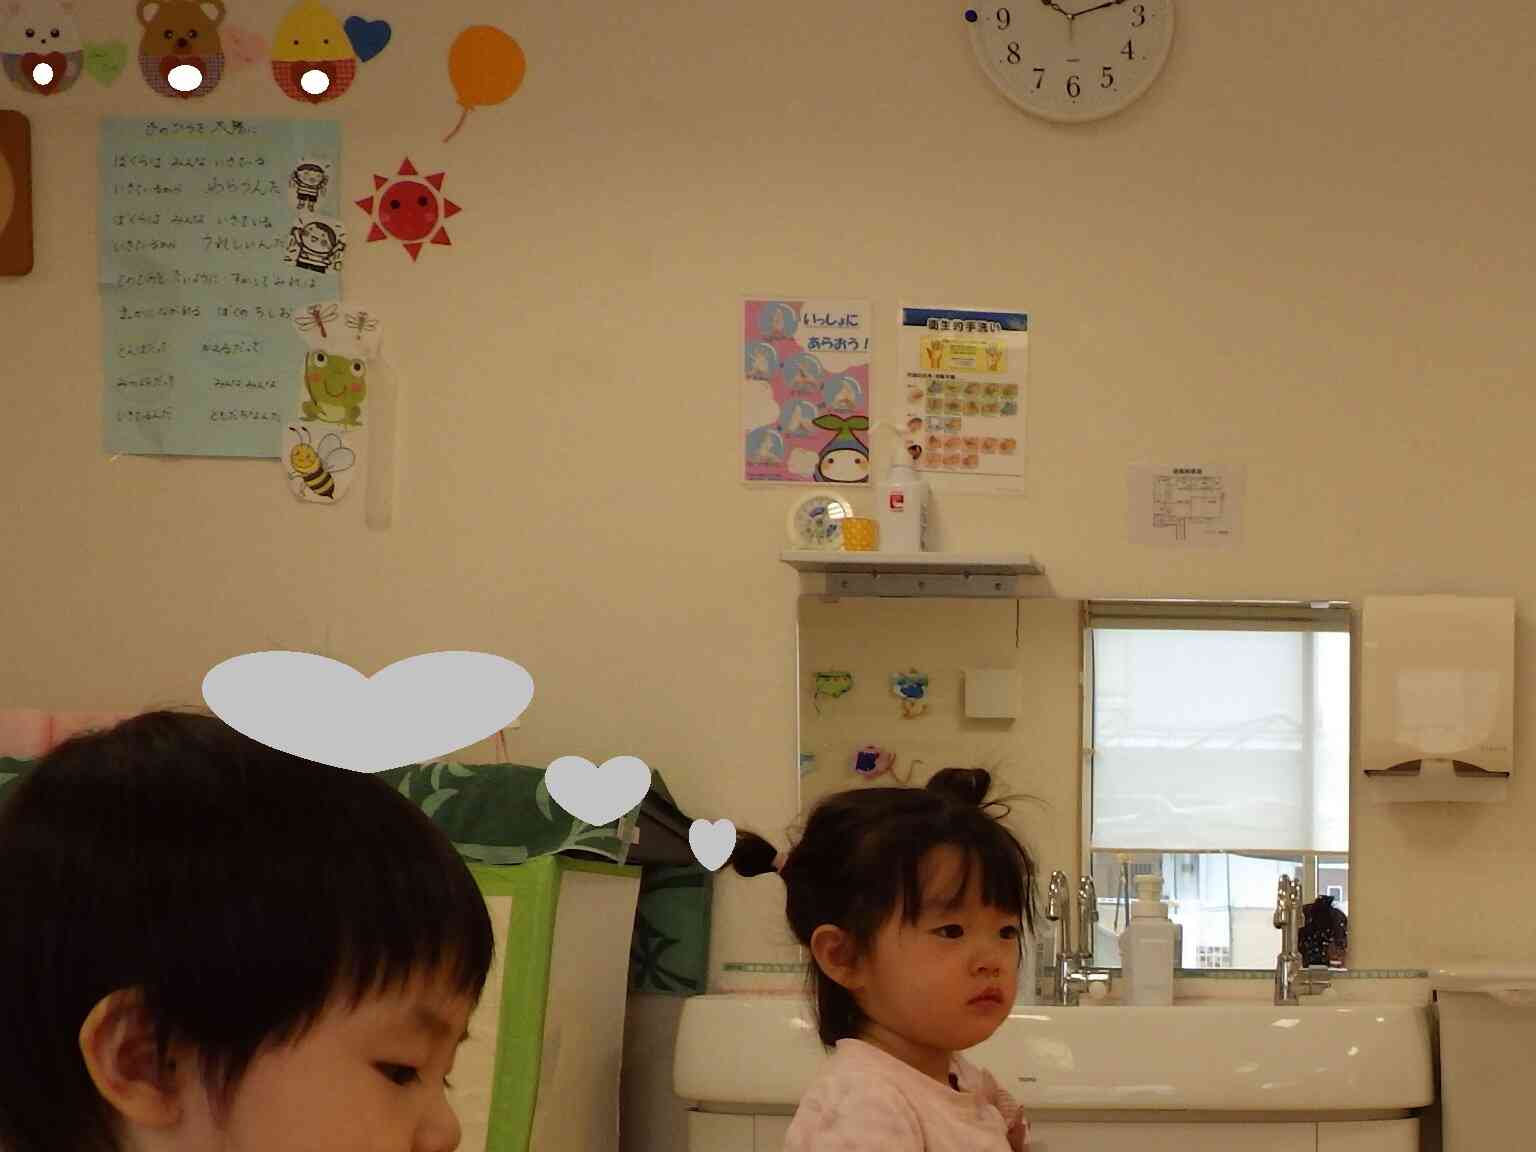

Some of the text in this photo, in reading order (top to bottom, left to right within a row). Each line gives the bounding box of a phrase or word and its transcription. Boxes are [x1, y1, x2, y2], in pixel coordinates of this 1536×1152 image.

[996, 7, 1011, 31] 9
[1131, 4, 1146, 28] 3
[1007, 41, 1022, 65] 8
[1120, 39, 1135, 61] 4
[1032, 67, 1046, 89] 7
[1066, 75, 1081, 98] 6
[1100, 66, 1115, 89] 5
[803, 313, 859, 328] いっしょに
